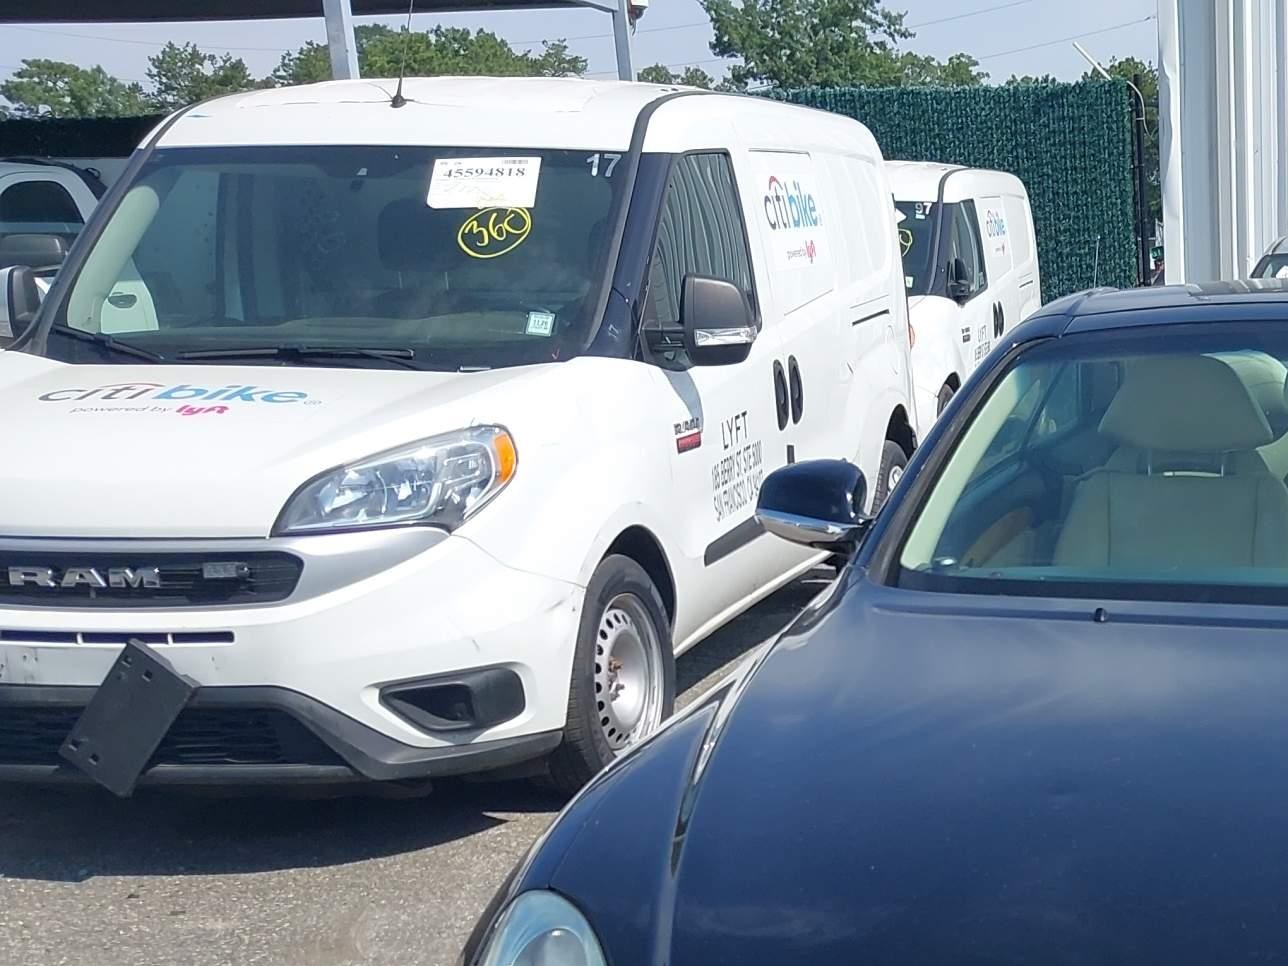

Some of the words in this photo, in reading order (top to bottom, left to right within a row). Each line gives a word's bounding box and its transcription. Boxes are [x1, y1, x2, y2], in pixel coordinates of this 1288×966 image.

[443, 167, 525, 178] 45594818
[586, 153, 622, 178] 17
[465, 207, 531, 247] 360
[721, 410, 748, 451] LYFT
[8, 567, 160, 587] RAM
